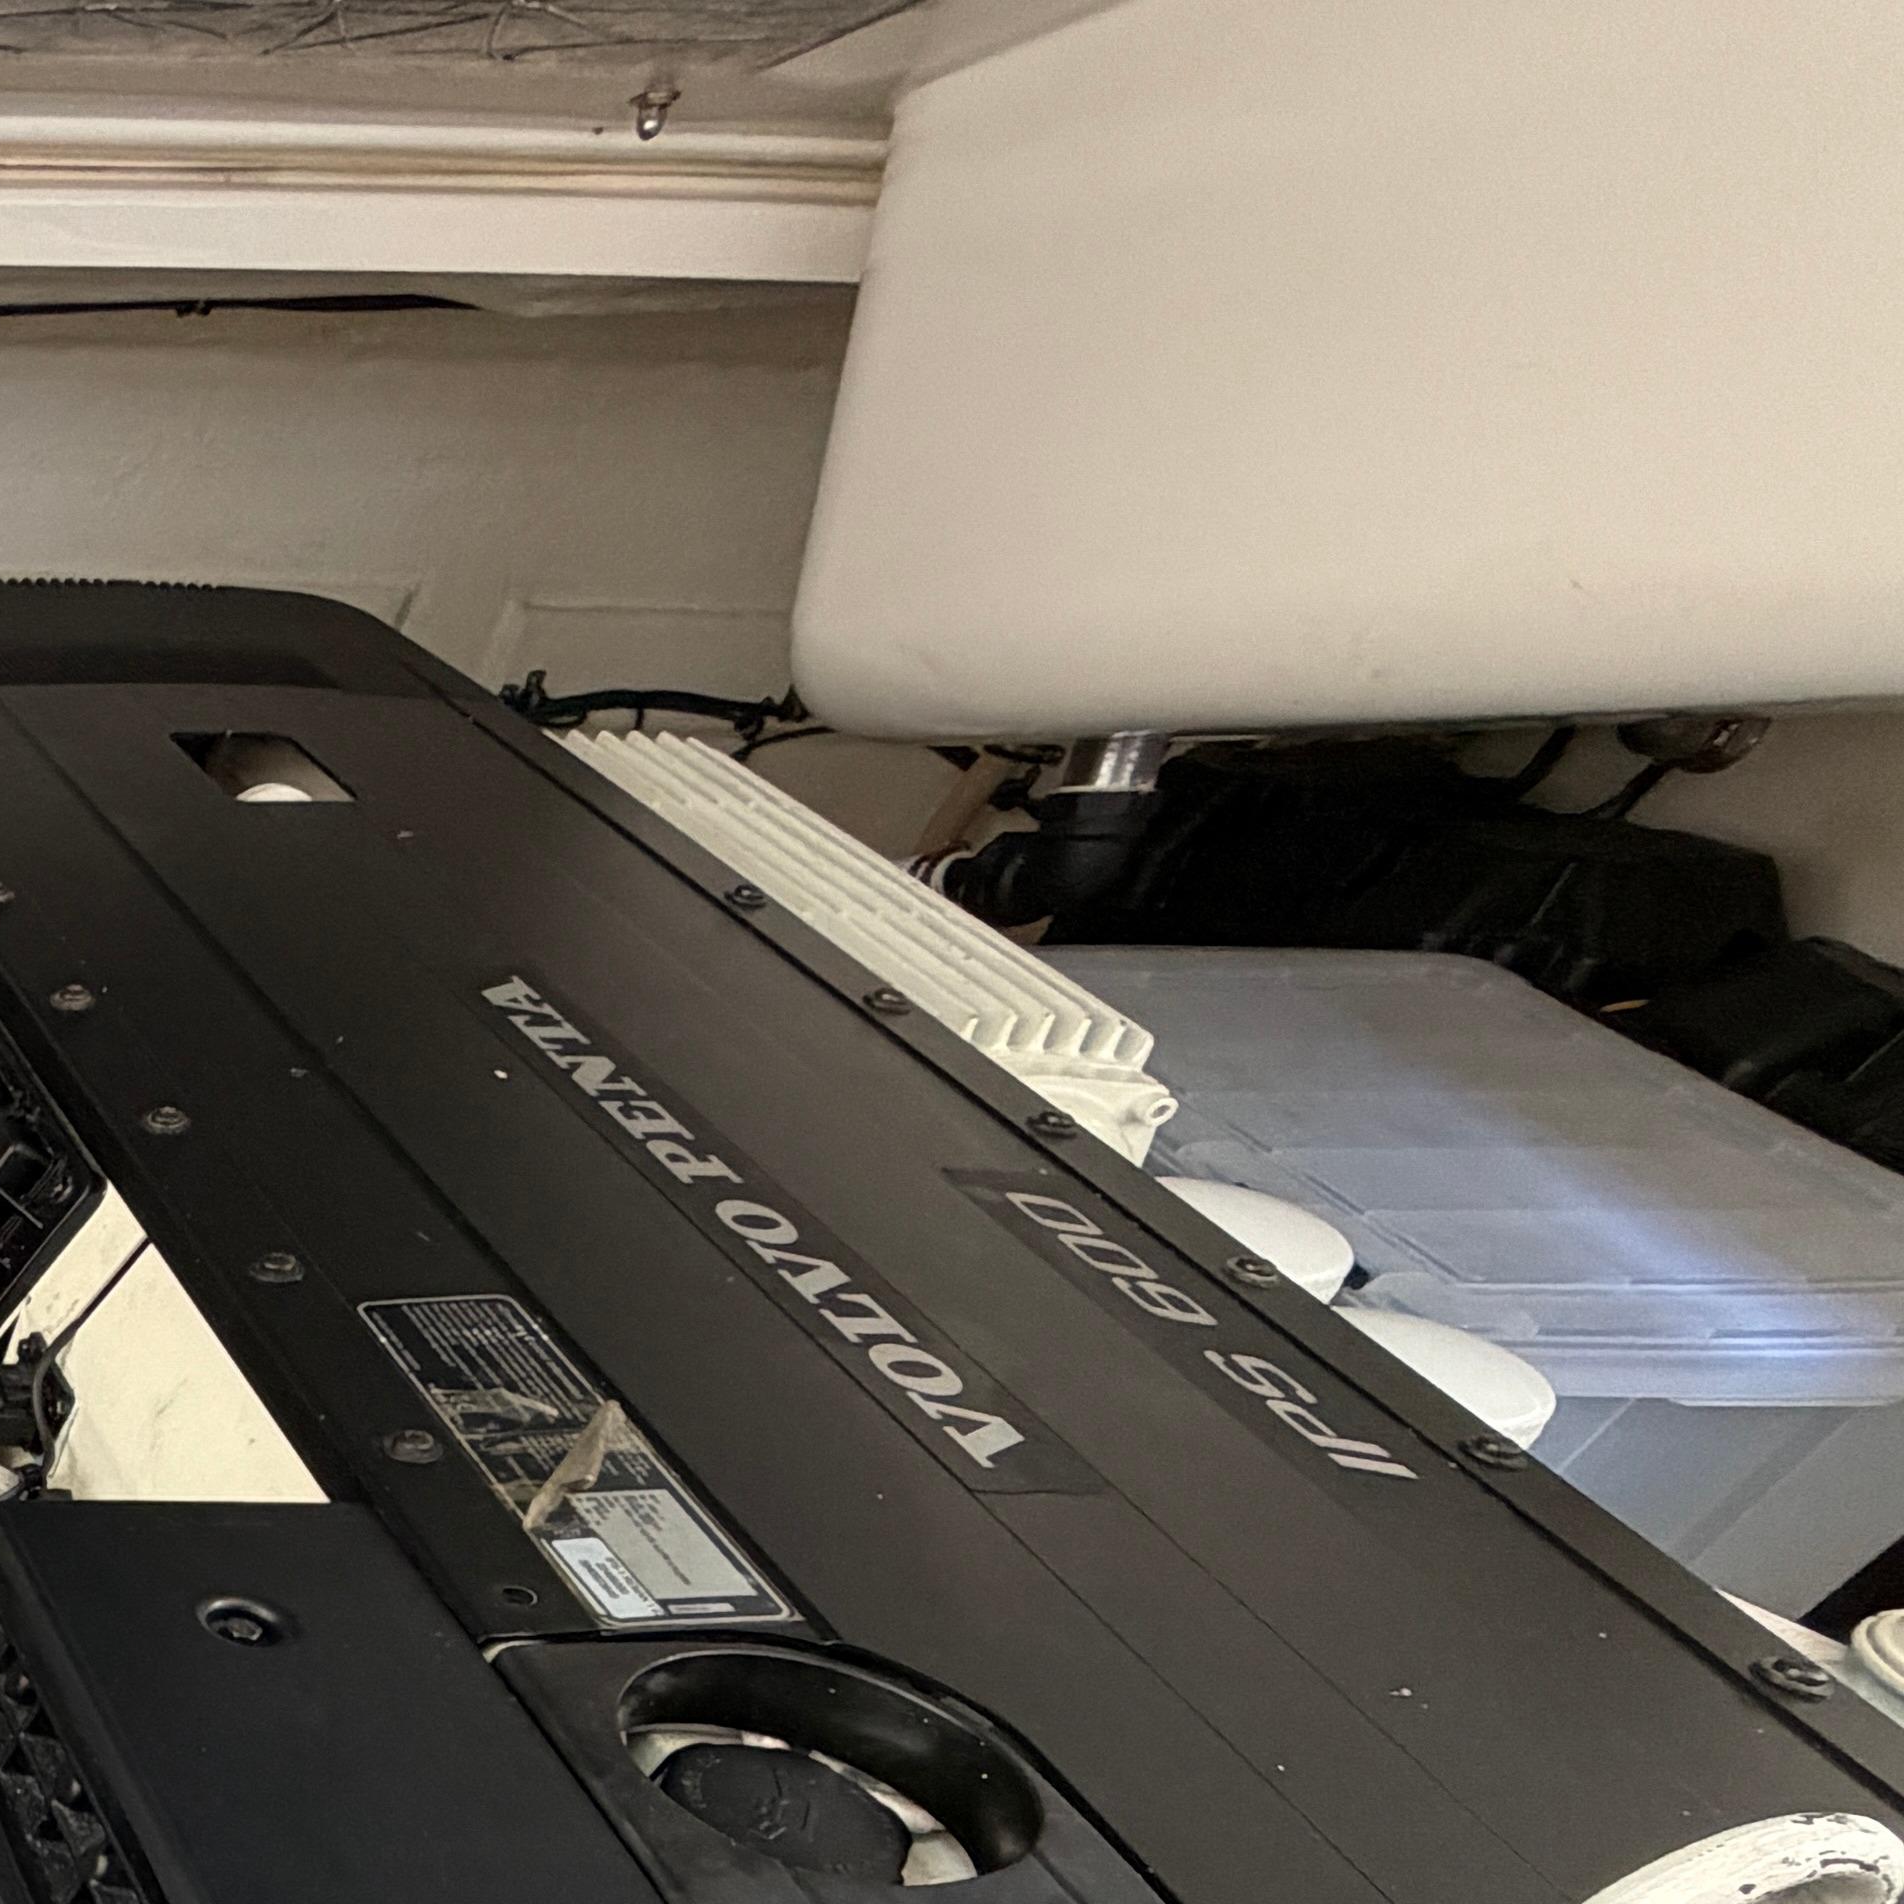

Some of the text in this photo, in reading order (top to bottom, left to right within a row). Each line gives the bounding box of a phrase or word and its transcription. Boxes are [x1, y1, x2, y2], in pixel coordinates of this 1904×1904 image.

[481, 975, 743, 1185] PENTA
[715, 1199, 1026, 1470] VOLVO
[1005, 1191, 1419, 1480] IPS 600
